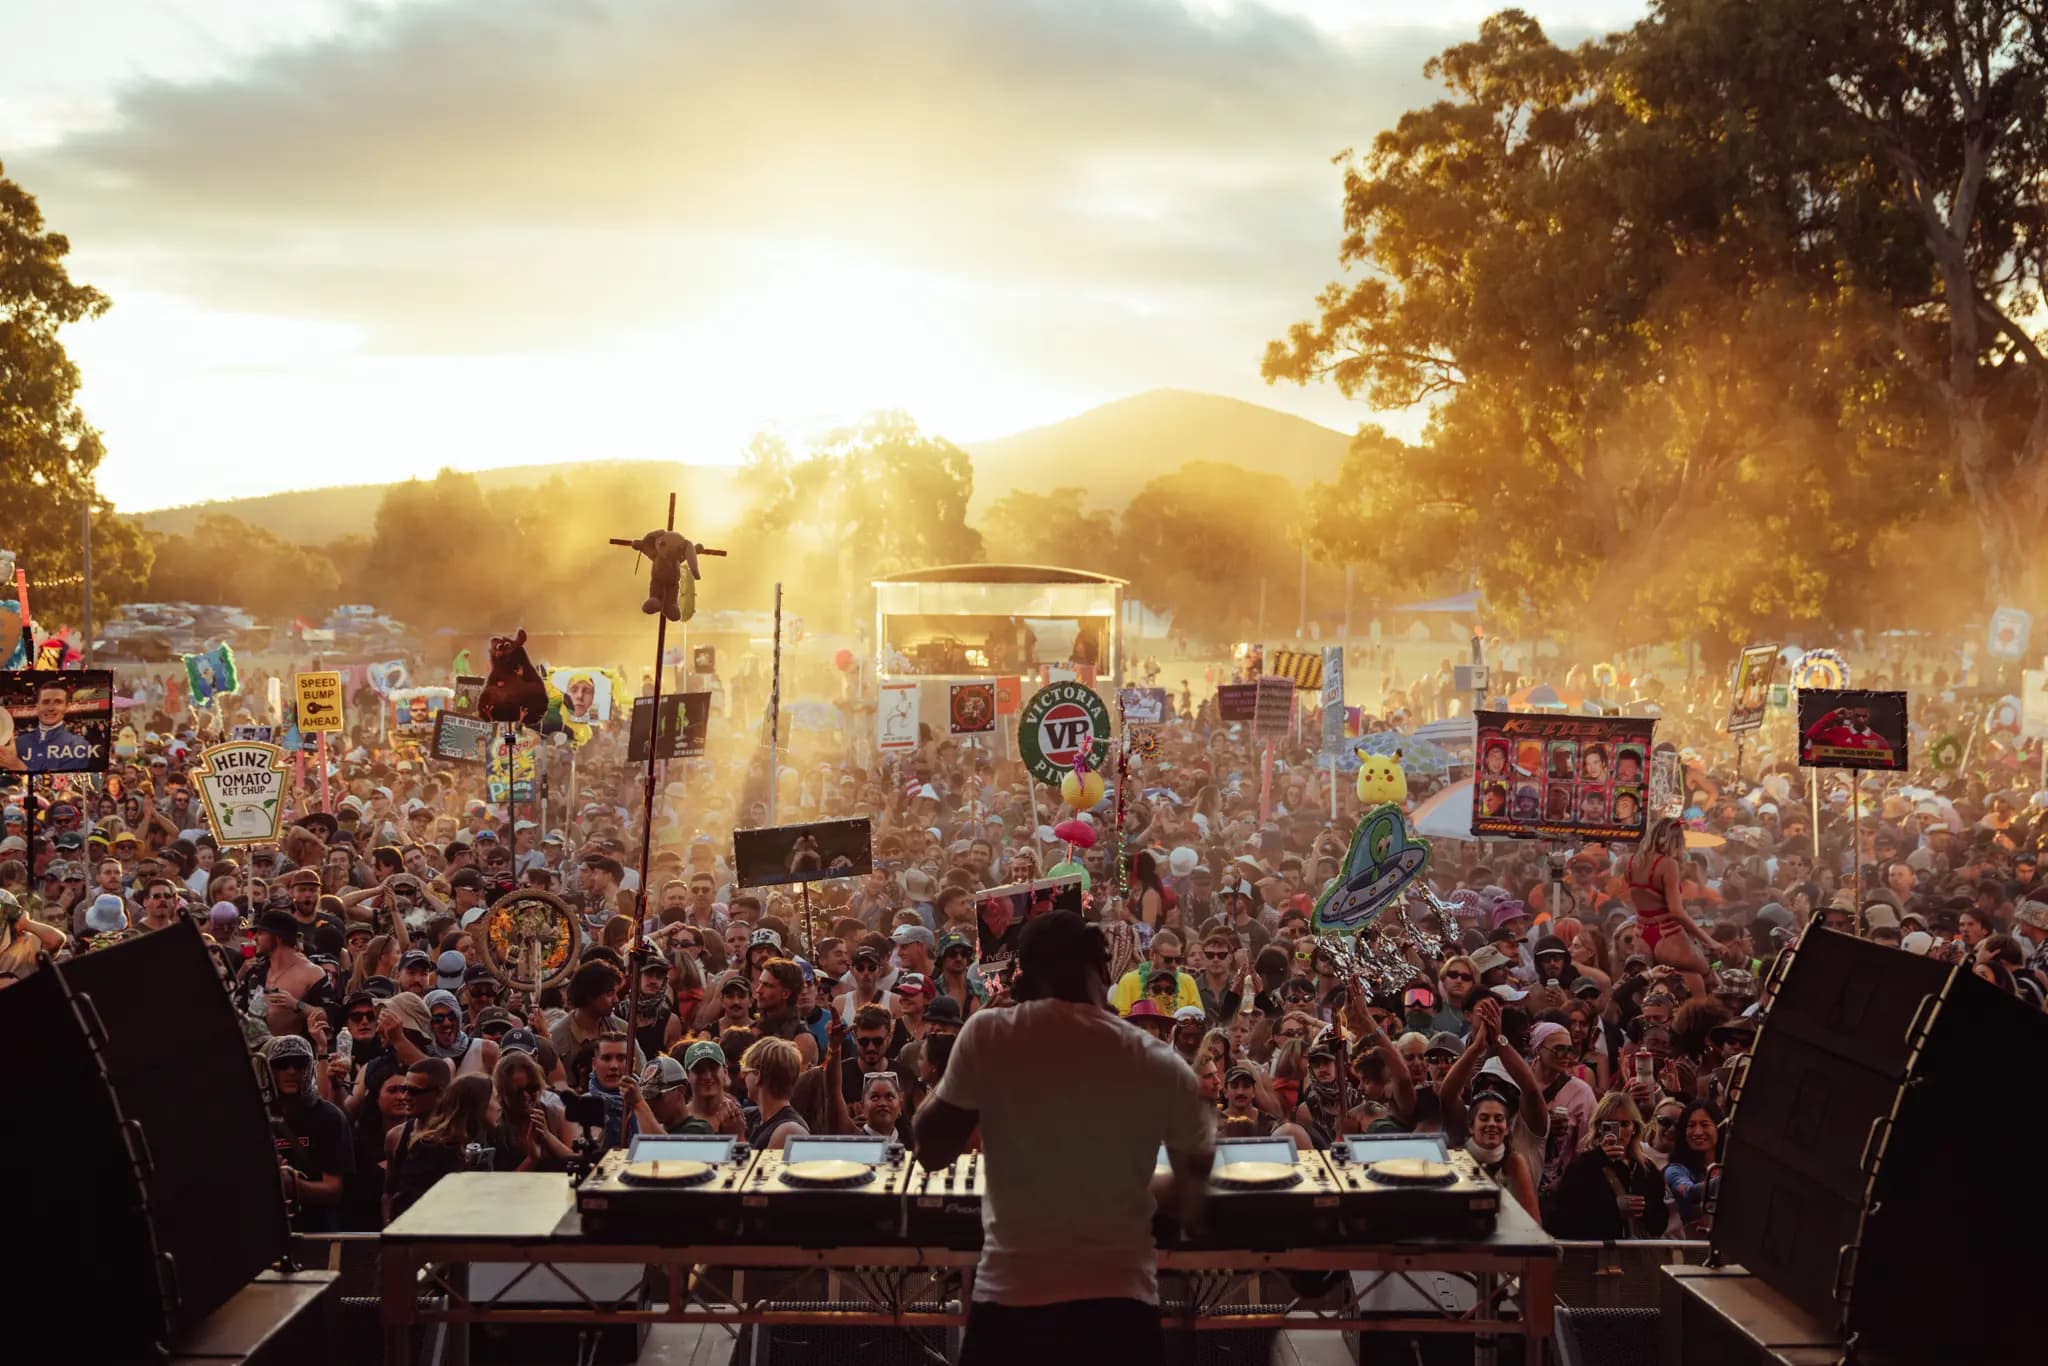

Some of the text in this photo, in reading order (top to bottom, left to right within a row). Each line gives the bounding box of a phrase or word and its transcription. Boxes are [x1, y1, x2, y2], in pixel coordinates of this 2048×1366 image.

[301, 678, 336, 688] SPEED
[303, 690, 334, 699] BUMP
[1026, 687, 1101, 723] VICTORIA
[303, 716, 339, 726] AHEAD
[1043, 720, 1089, 750] VP
[22, 747, 32, 761] J
[47, 744, 101, 760] RACK
[214, 751, 268, 771] HEINZ
[1034, 752, 1101, 783] PINR
[215, 772, 272, 788] TOMATO
[1478, 823, 1526, 833] CHOOS
